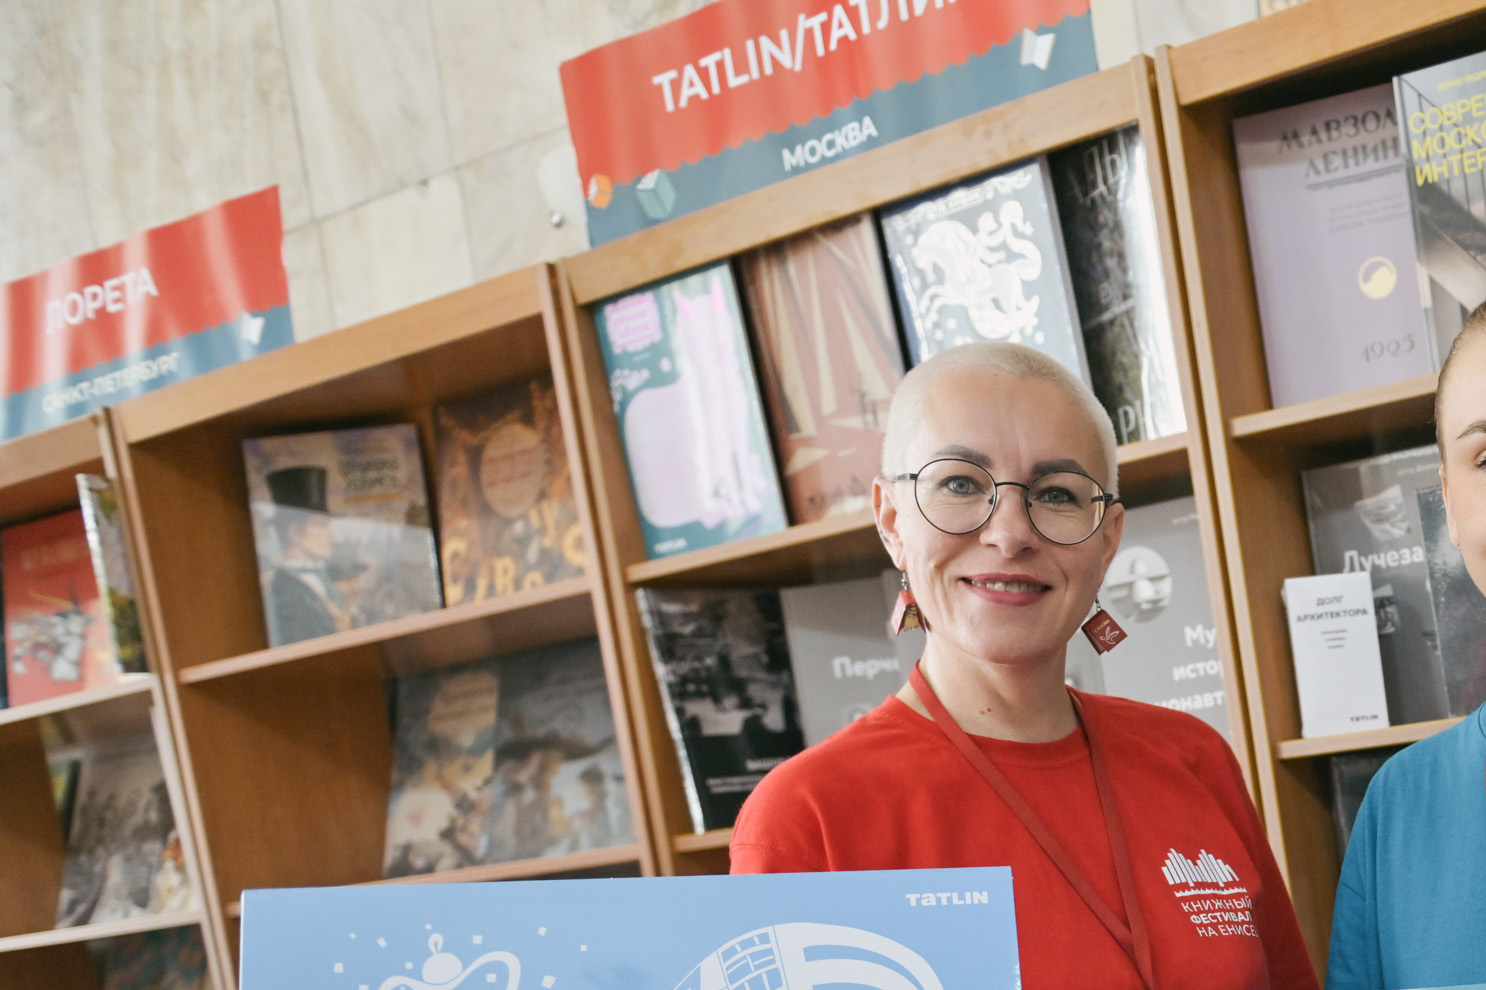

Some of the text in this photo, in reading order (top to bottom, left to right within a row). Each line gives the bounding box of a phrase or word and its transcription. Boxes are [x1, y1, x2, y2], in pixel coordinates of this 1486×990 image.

[781, 115, 879, 172] МОСКВА
[1315, 595, 1345, 606] ДОЛГ
[1295, 607, 1369, 623] АРХИТЕКТОРА
[1181, 895, 1252, 913] КНИЖНЫЙ
[1196, 925, 1219, 938] НА
